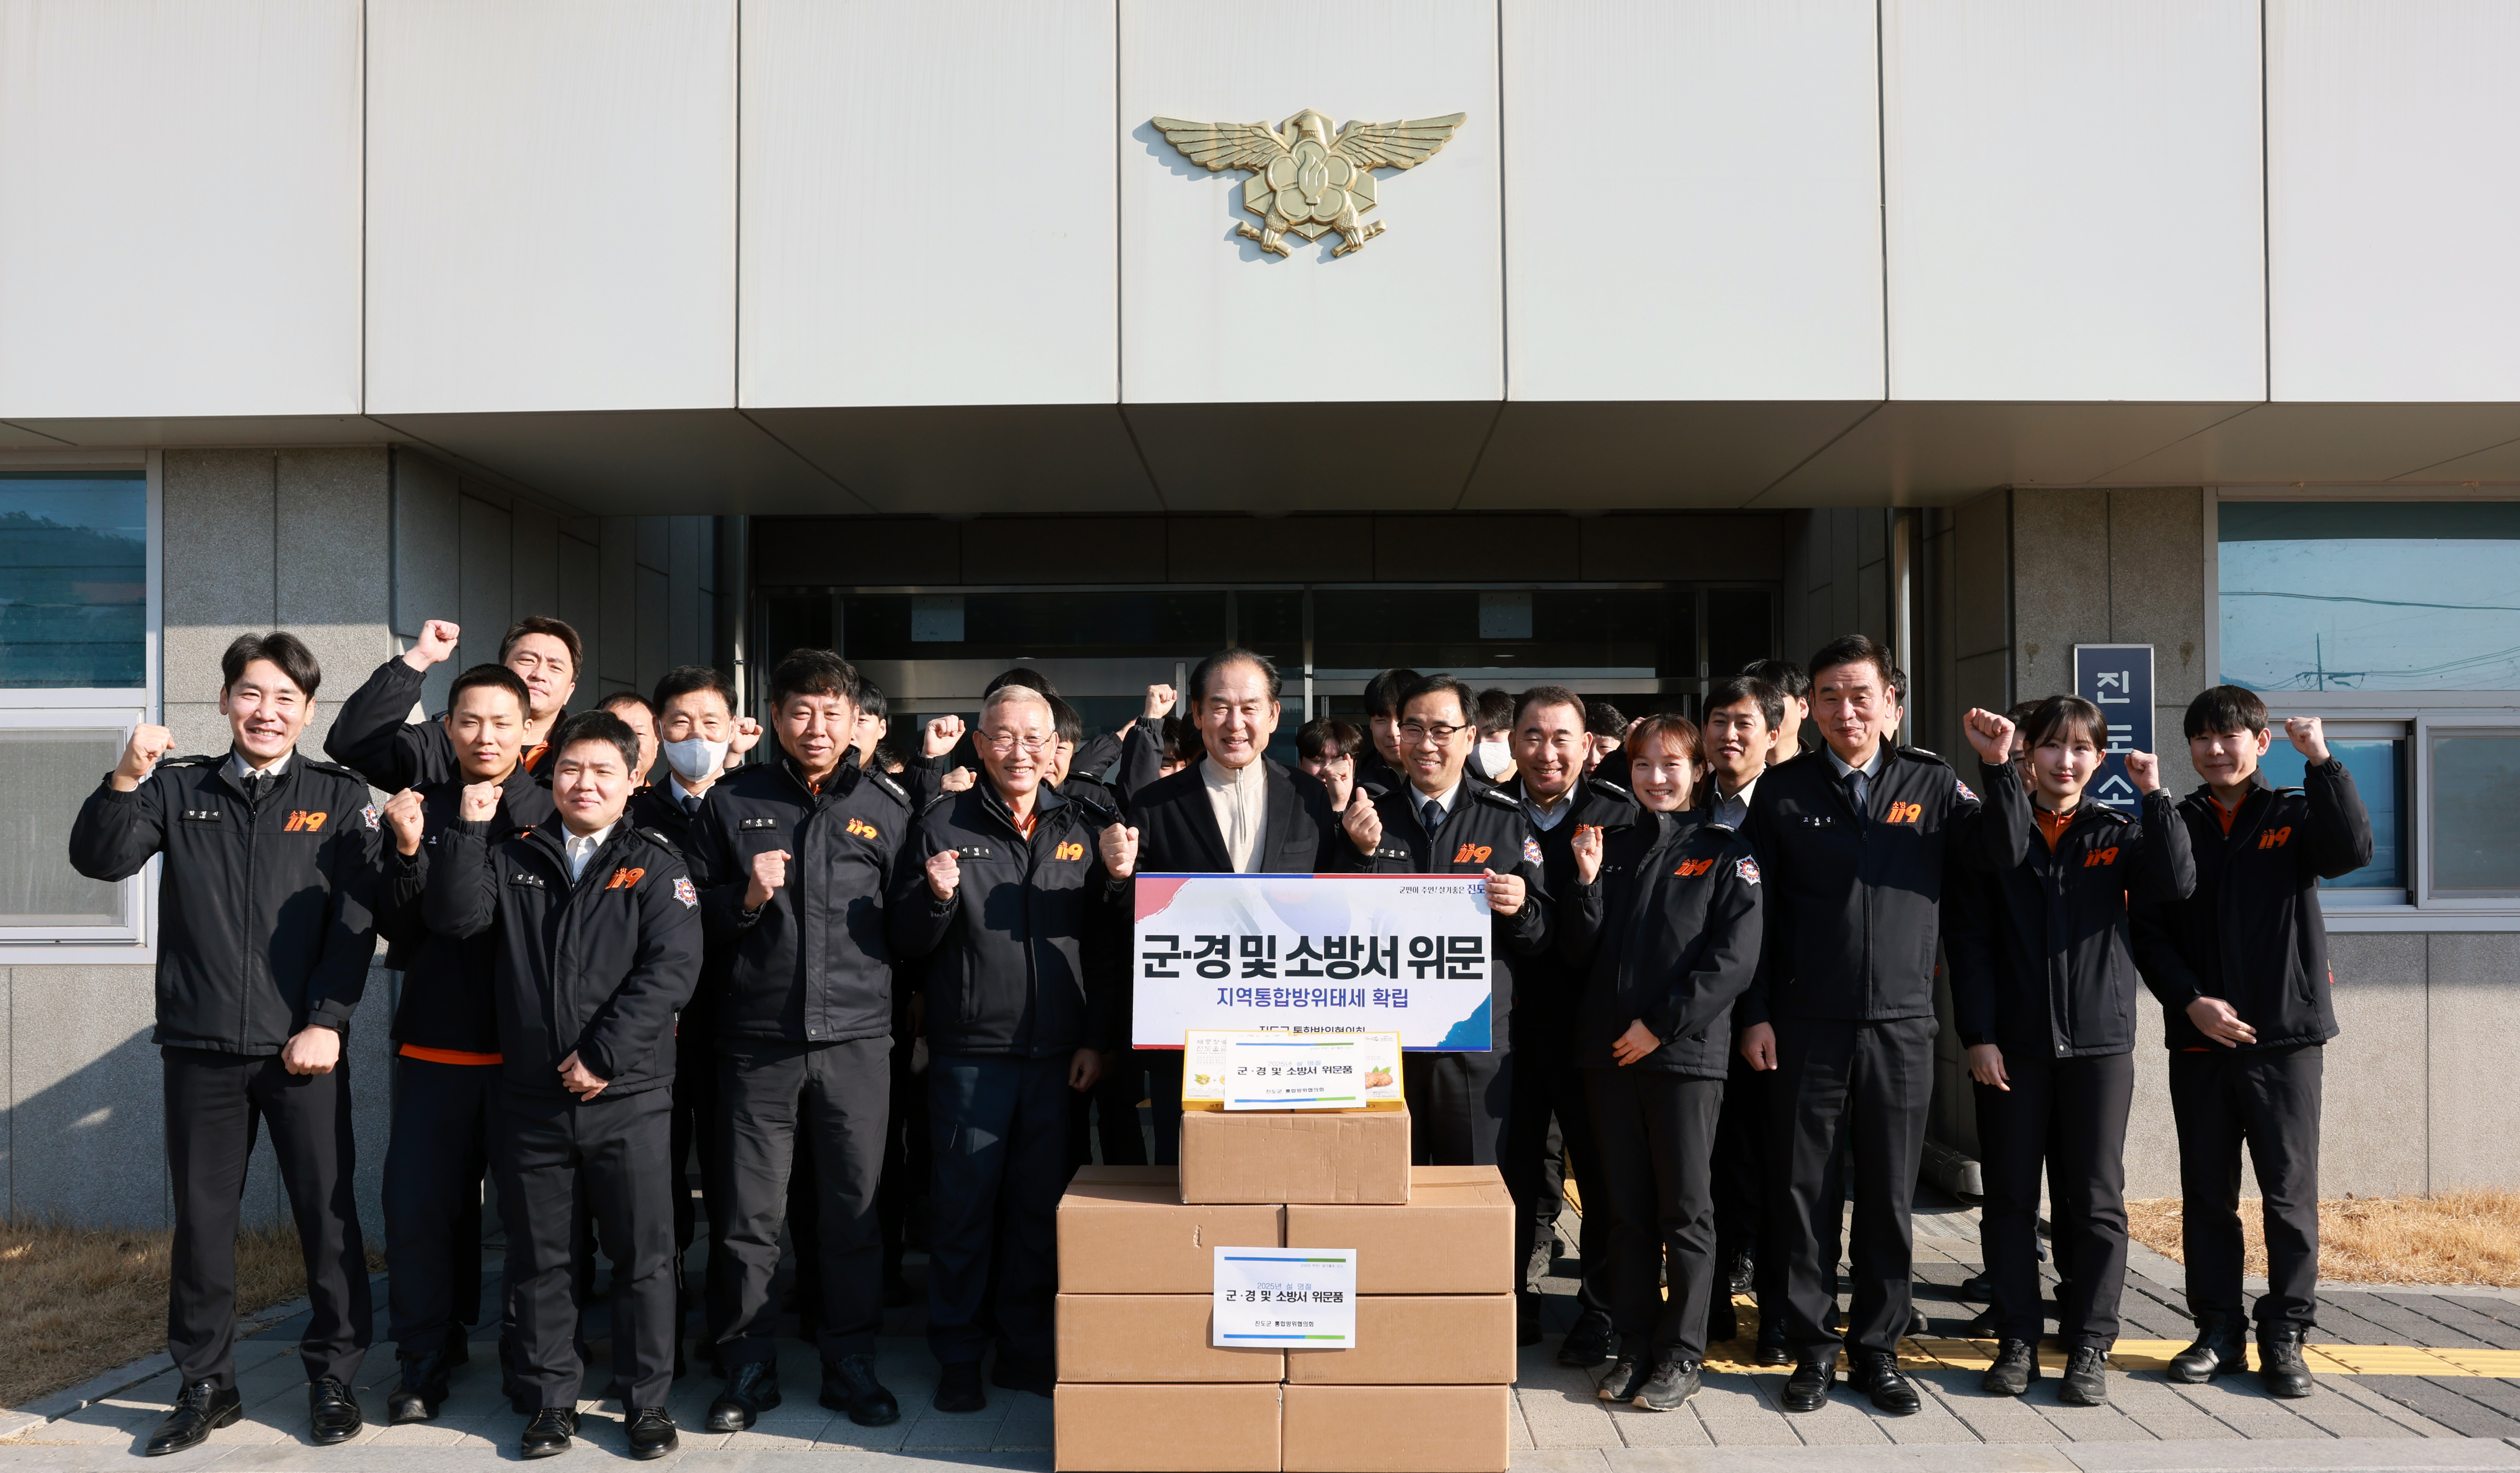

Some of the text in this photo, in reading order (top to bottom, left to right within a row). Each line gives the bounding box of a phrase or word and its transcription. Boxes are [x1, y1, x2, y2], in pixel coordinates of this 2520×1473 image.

[284, 812, 328, 831] 119
[1886, 803, 1922, 823] 119
[845, 824, 877, 840] 119
[2258, 826, 2292, 849] 119
[1055, 843, 1084, 861] 119
[1453, 846, 1493, 863] 119
[2083, 847, 2119, 868] 119
[1674, 859, 1714, 876] 119
[604, 868, 646, 890] 119
[1467, 884, 1486, 895] 진도
[1142, 935, 1485, 980] 군·경 및 소방서 위문
[1217, 987, 1408, 1008] 지역통합방위태세 확립
[1286, 1067, 1317, 1075] 소방서
[1322, 1066, 1353, 1074] 위문품
[1261, 1290, 1271, 1302] 및
[1276, 1291, 1307, 1303] 소방서
[1312, 1292, 1344, 1303] 위문품
